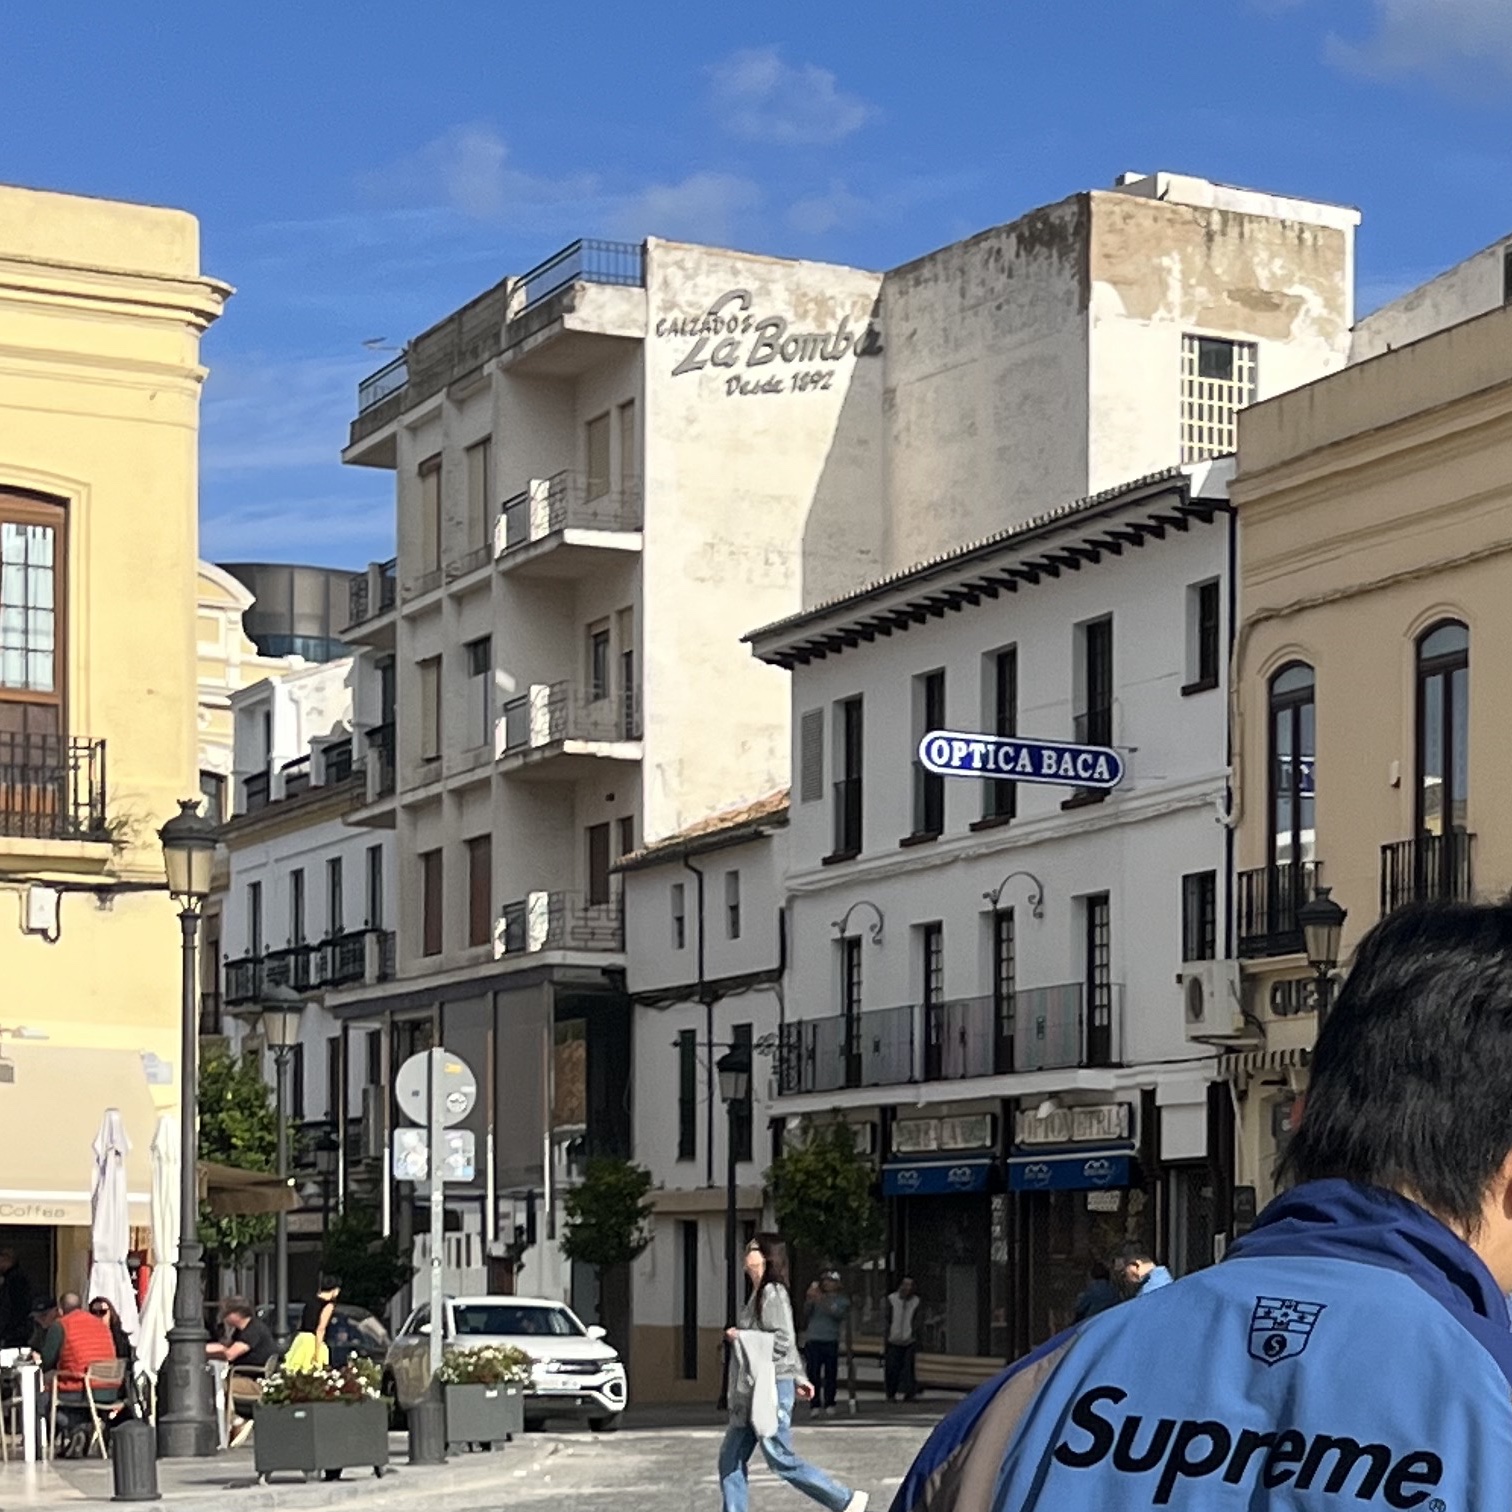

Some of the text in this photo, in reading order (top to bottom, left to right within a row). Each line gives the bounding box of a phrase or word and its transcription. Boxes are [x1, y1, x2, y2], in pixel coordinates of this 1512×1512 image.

[656, 314, 755, 338] CALZADOS
[746, 314, 884, 368] Bomba
[725, 369, 836, 396] Desde 1892
[930, 738, 1111, 780] OPTICA BACA
